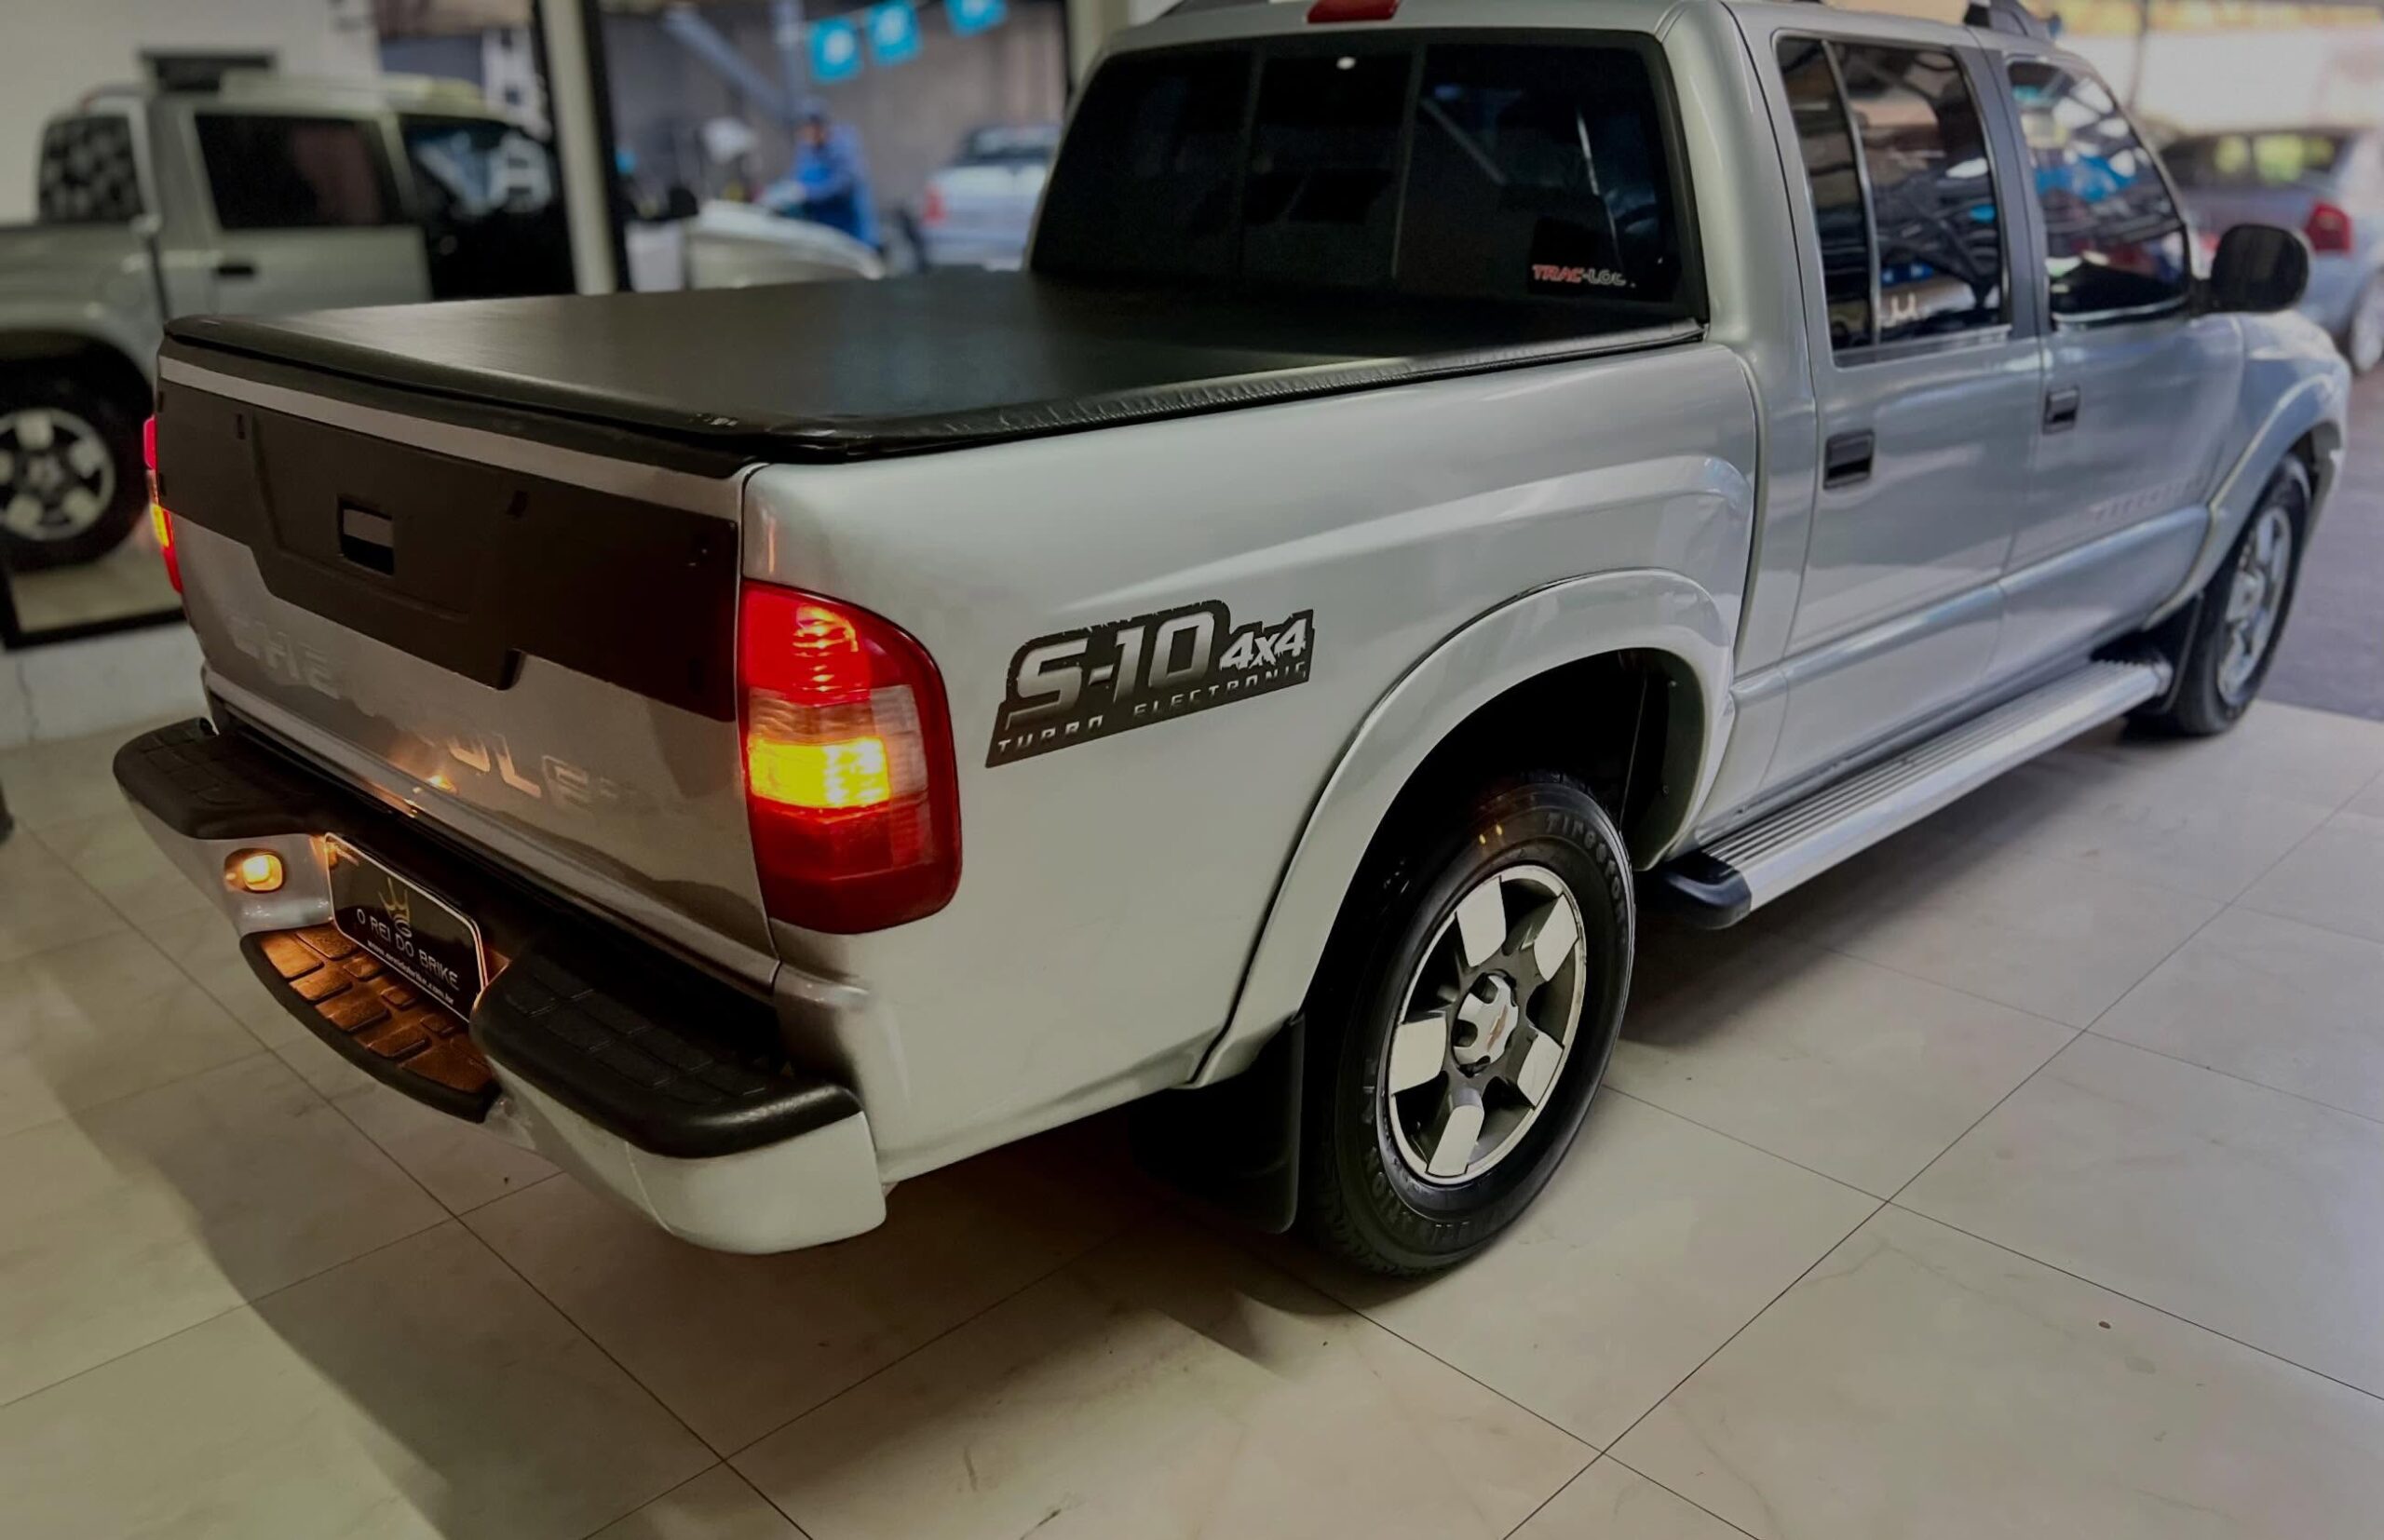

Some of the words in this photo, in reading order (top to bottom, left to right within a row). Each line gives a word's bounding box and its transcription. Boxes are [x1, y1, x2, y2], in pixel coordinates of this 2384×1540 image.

[1005, 611, 1215, 731] S-10
[1218, 618, 1307, 671] 4x4
[1132, 660, 1307, 717] ELECTRONIC
[357, 909, 366, 925] O
[370, 916, 392, 942] REI
[395, 934, 414, 957] DO
[419, 949, 460, 991] BRIKE
